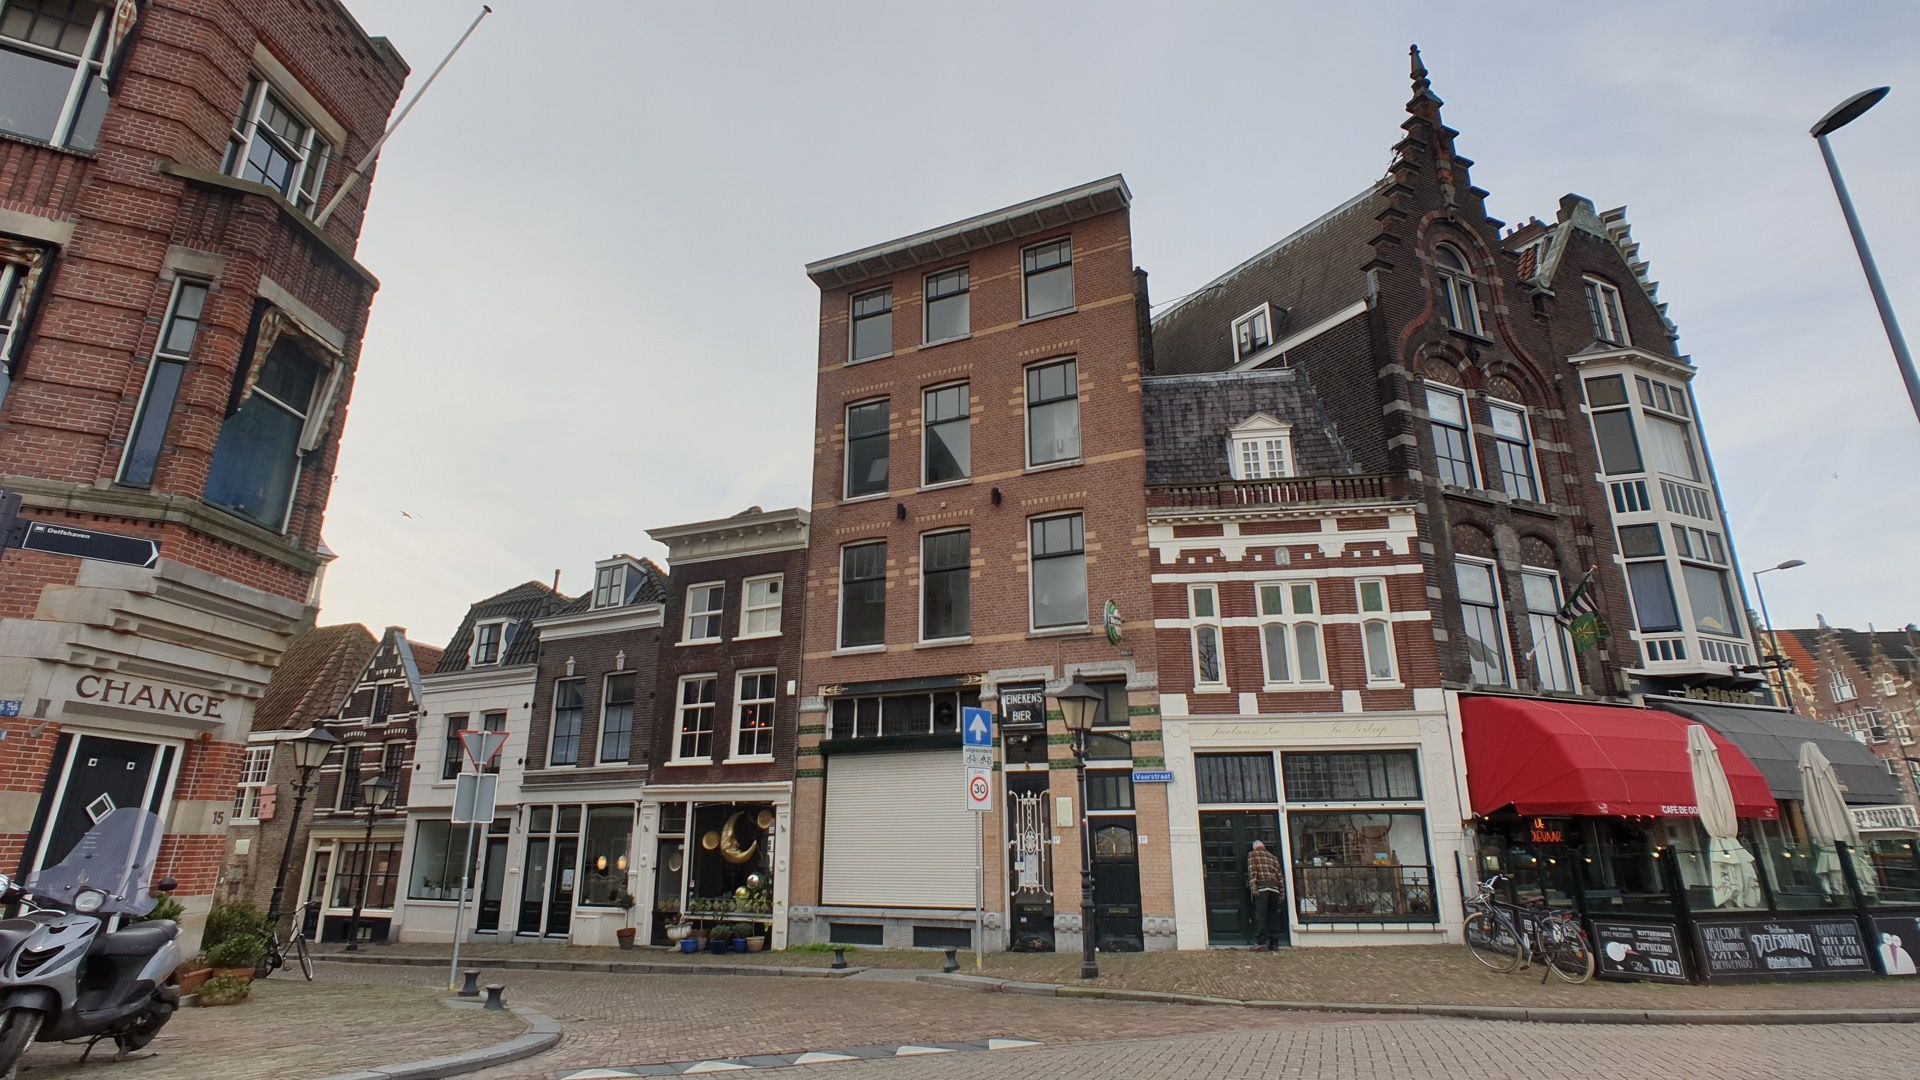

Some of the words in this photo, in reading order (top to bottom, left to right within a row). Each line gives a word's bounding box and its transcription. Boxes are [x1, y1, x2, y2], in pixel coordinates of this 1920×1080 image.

[47, 527, 91, 540] Delfshaven
[75, 674, 226, 719] CHANGE
[1001, 692, 1043, 705] HEINEKEN'S
[1012, 710, 1032, 721] BIER
[973, 783, 986, 794] 30
[1679, 805, 1688, 814] DE
[212, 811, 224, 825] 15
[1703, 927, 1745, 940] WELCOME
[1636, 942, 1673, 954] CAPPUCCINO
[1751, 933, 1816, 958] DELFSHAVEN
[1648, 958, 1666, 974] TO
[1667, 960, 1681, 976] GO
